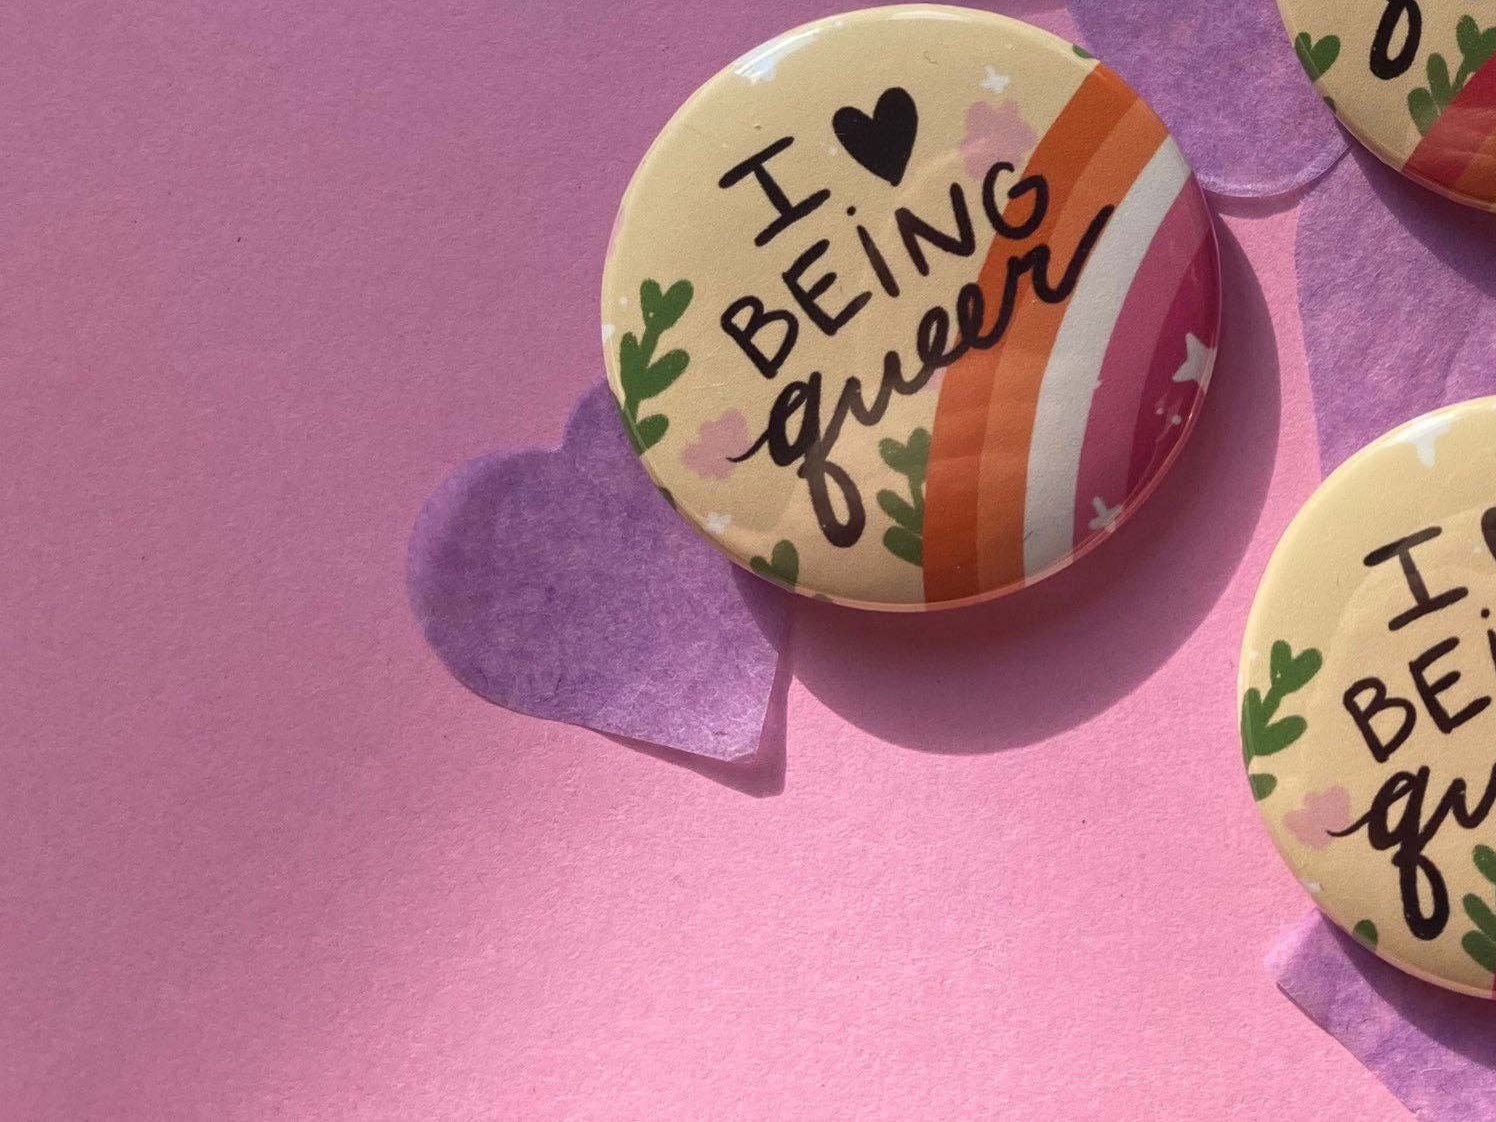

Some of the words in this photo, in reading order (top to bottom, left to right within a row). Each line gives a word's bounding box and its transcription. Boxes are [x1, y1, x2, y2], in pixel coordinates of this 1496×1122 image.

[719, 137, 831, 247] I
[727, 206, 1115, 548] queer
[1363, 527, 1468, 631] I
